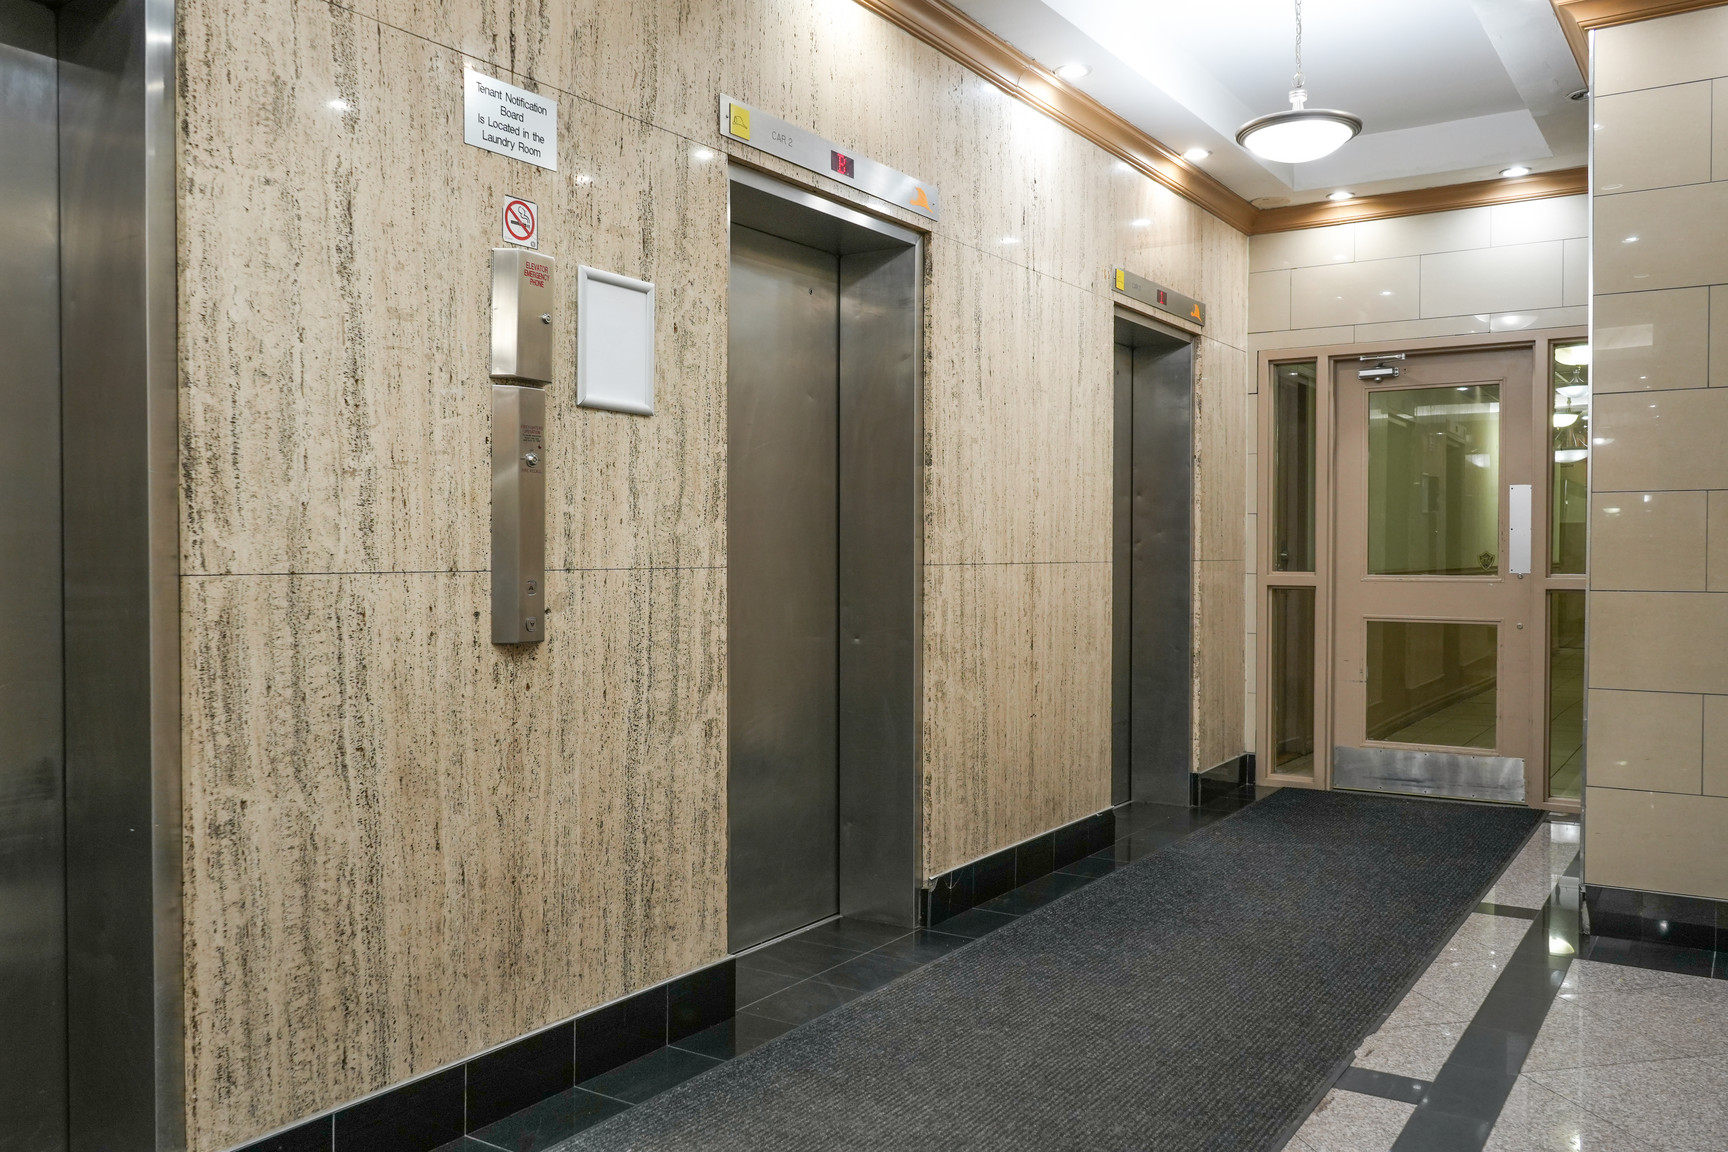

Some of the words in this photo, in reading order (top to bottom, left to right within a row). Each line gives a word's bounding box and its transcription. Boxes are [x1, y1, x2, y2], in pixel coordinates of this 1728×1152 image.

[476, 81, 502, 100] Tenant
[505, 92, 547, 116] Notification
[500, 105, 524, 122] Board
[478, 113, 485, 124] Is
[488, 116, 520, 136] Located
[522, 128, 530, 139] in
[532, 132, 544, 144] the
[482, 129, 515, 152] Laundry
[518, 141, 541, 158] Room
[771, 130, 787, 145] CAR
[788, 137, 793, 148] 2
[524, 269, 550, 282] EMERGENCY
[525, 261, 548, 274] ELEVATOR
[530, 278, 544, 288] PHONE
